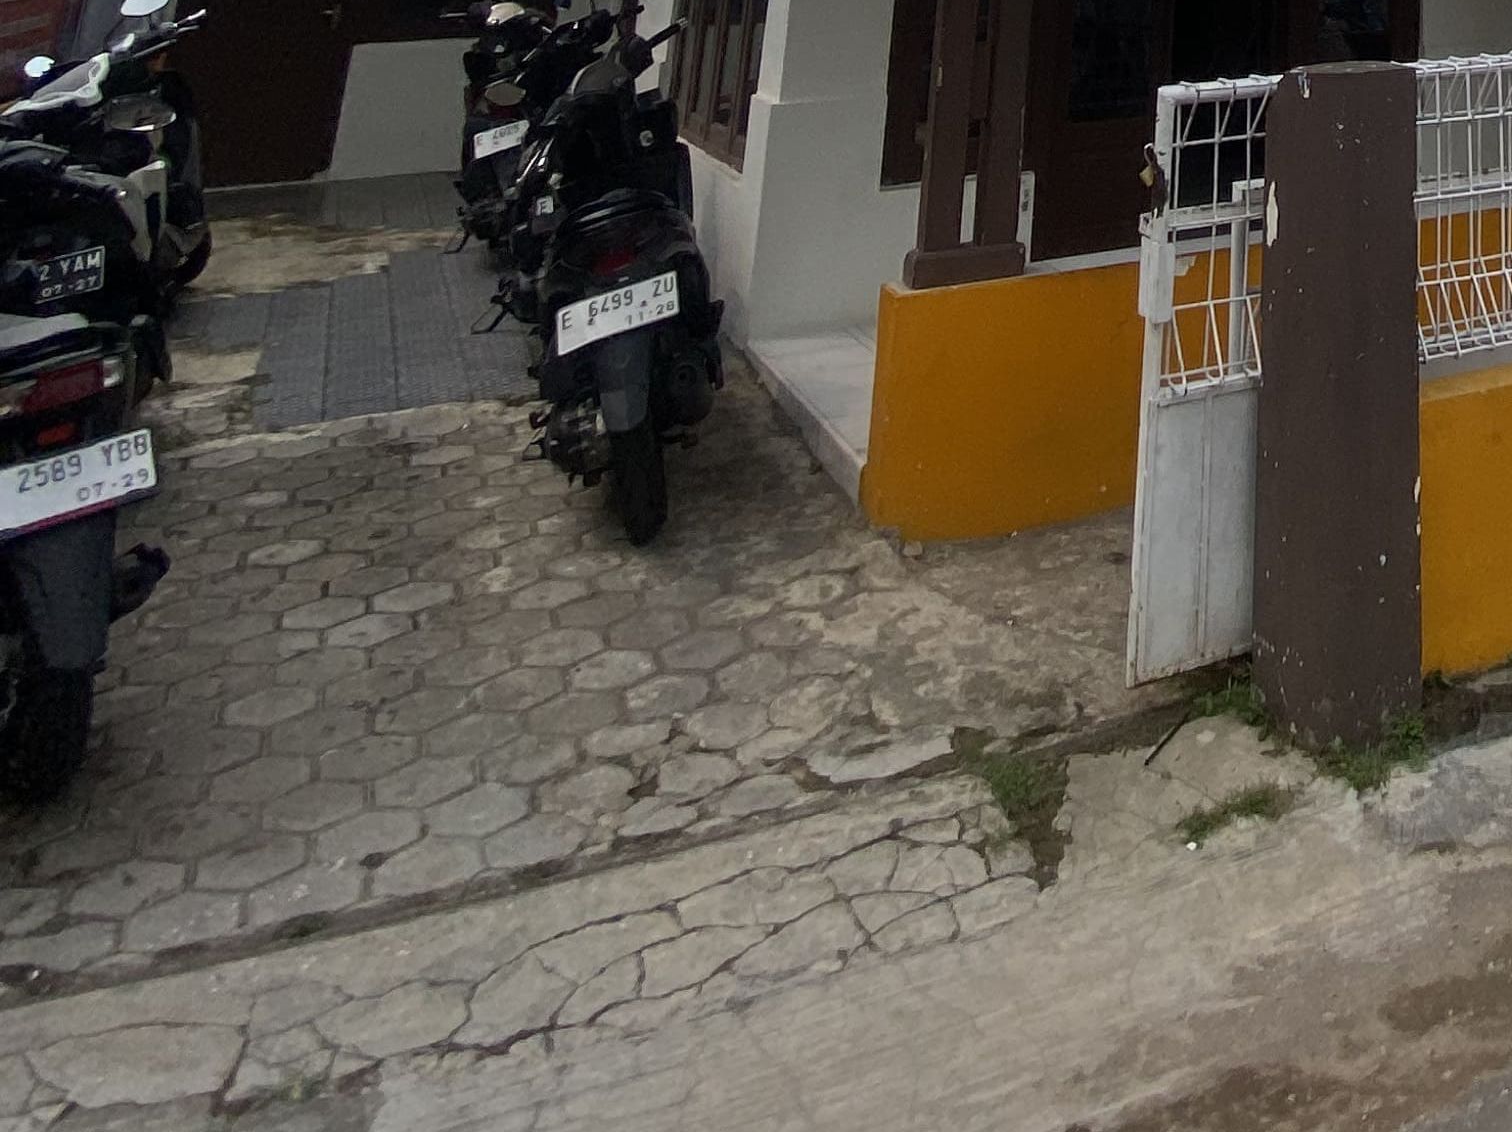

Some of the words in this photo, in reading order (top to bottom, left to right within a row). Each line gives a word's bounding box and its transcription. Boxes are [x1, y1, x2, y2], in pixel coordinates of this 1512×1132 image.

[561, 311, 573, 330] E
[589, 289, 633, 318] 6499
[653, 275, 675, 298] ZU
[17, 453, 82, 493] 2589
[102, 434, 148, 466] YBB
